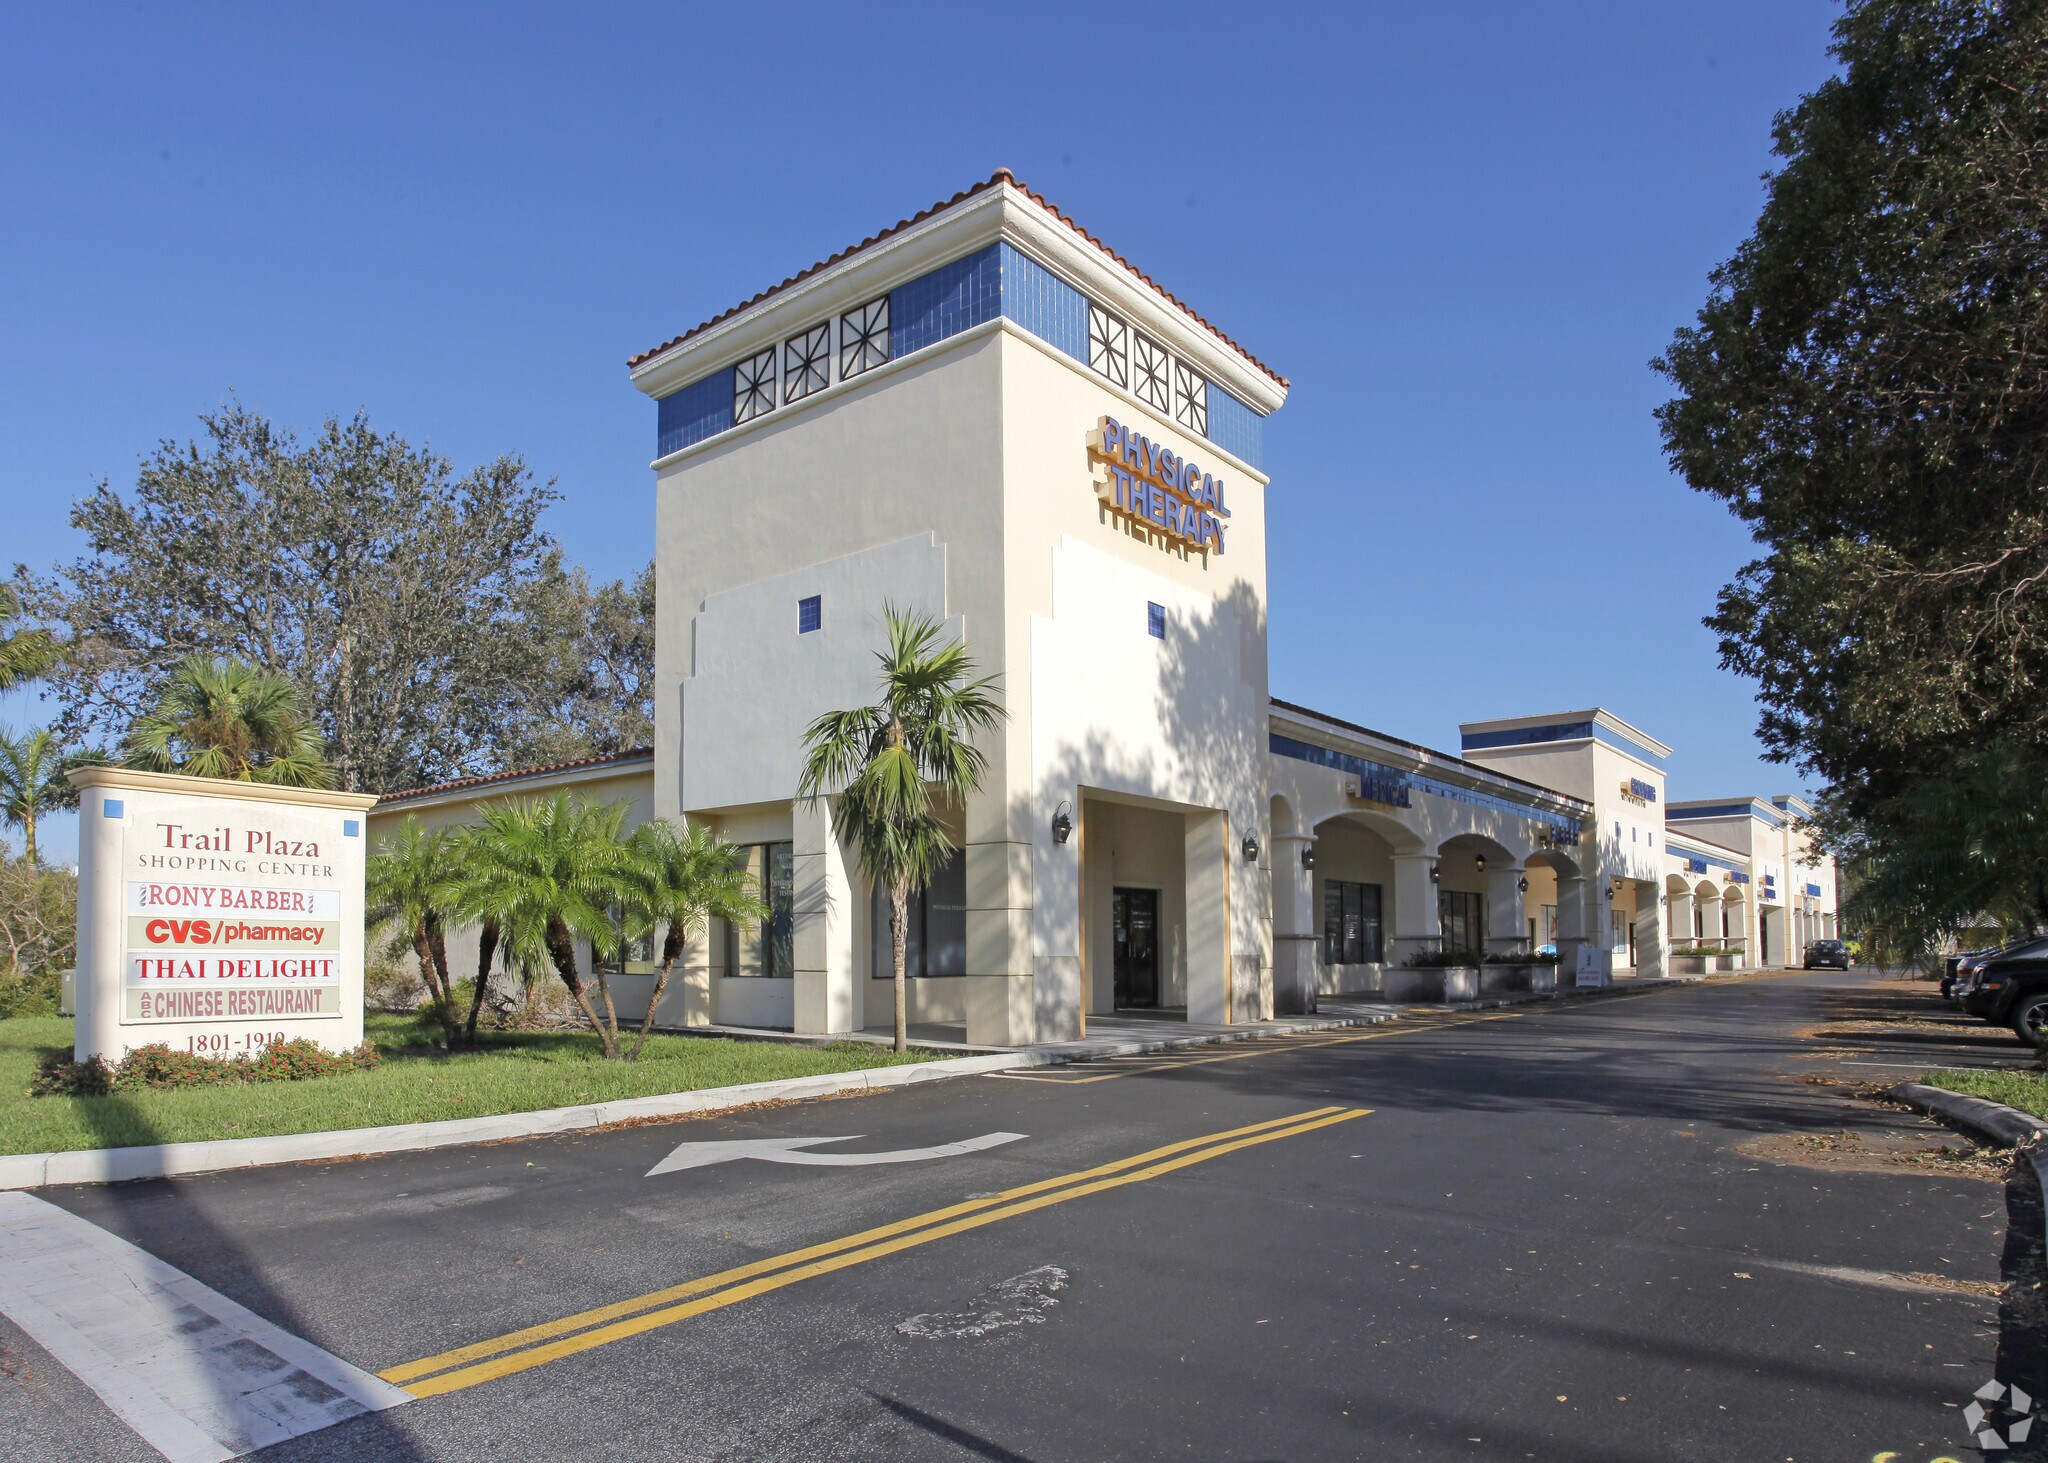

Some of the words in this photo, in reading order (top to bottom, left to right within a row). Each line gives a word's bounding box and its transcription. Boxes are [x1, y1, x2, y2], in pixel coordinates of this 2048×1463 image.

[1104, 416, 1231, 518] PHYSICAL
[1111, 465, 1225, 555] THERAPY
[1361, 776, 1412, 809] MEDICAL
[156, 823, 231, 852] Trail
[245, 830, 320, 858] Plaza
[138, 854, 247, 873] SHOPPING
[258, 861, 333, 877] CENTER
[149, 884, 216, 907] RONY
[220, 888, 306, 912] BARBER
[145, 919, 325, 945] CVS/pharmacy
[135, 959, 208, 979] THAI
[216, 959, 334, 978] DELIGHT
[154, 991, 223, 1018] CHINESE
[228, 988, 322, 1016] RESTAURANT
